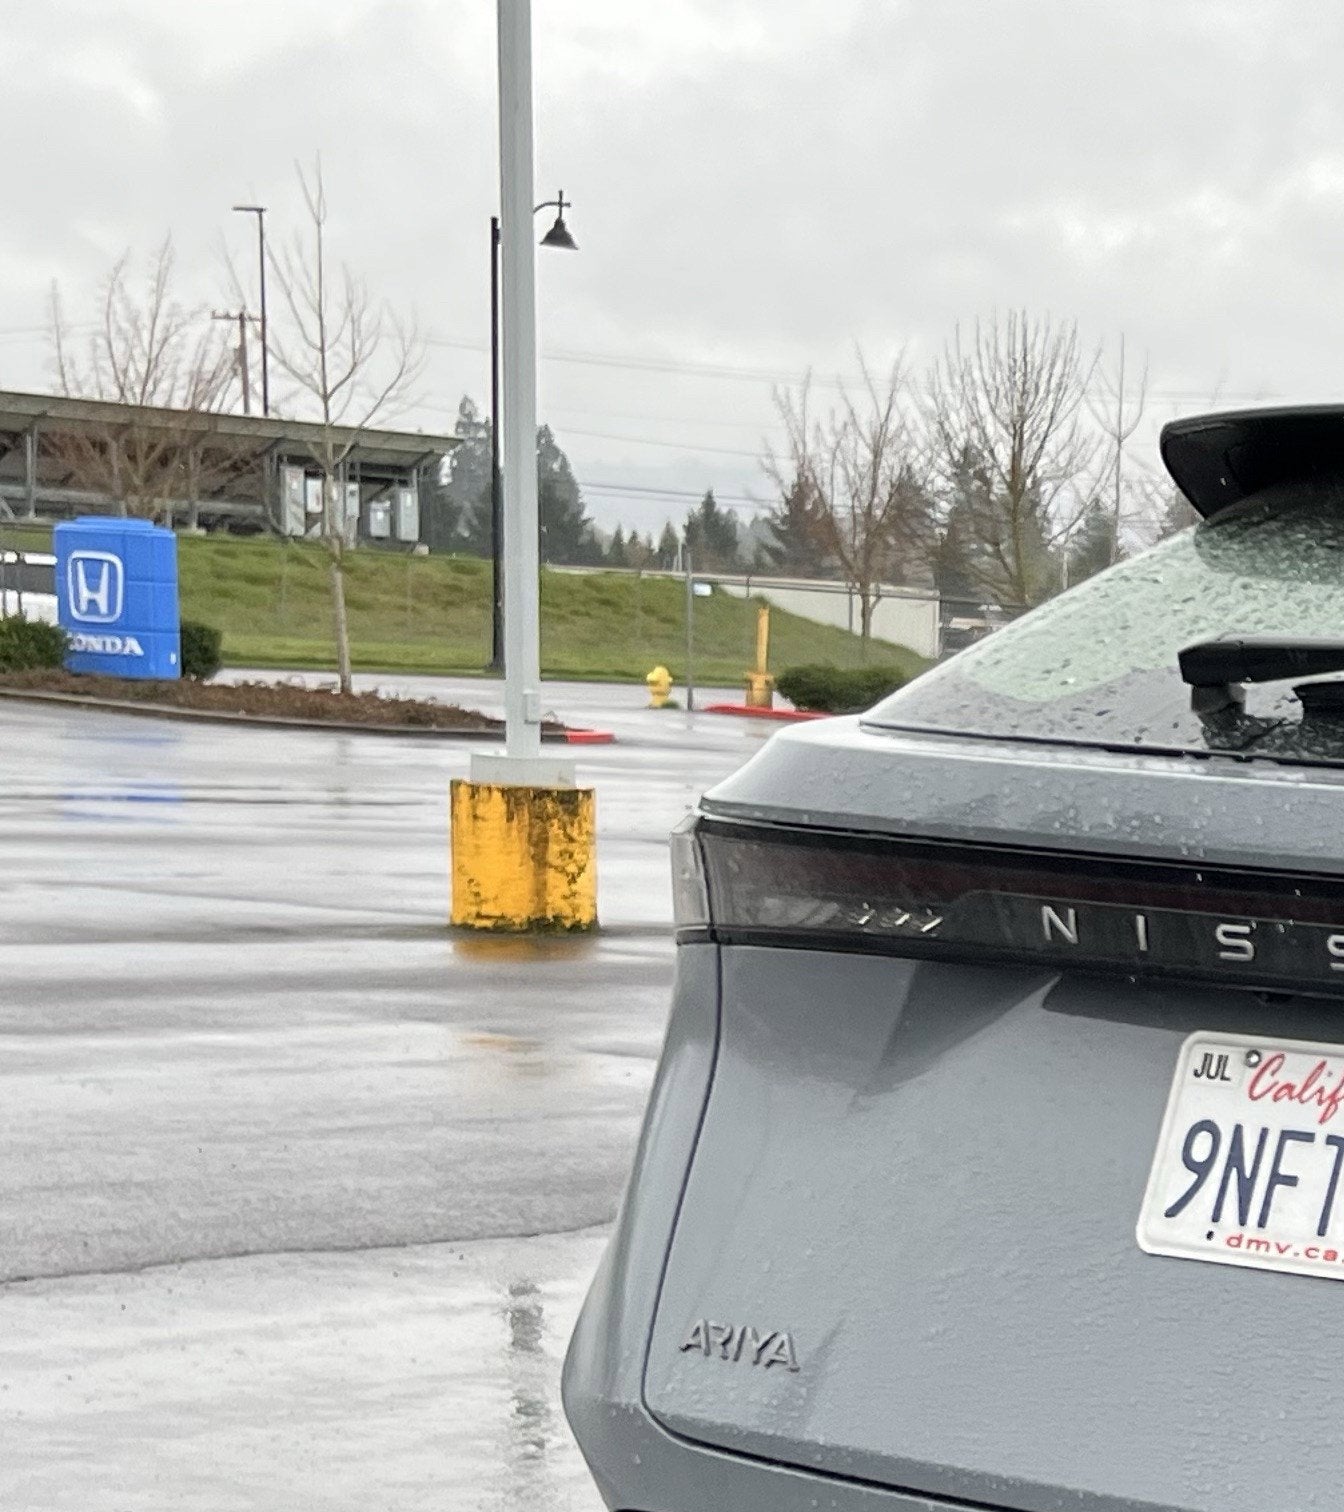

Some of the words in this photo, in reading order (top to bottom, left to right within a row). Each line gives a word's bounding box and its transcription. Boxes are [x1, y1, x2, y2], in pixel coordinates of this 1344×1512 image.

[67, 632, 145, 657] ONDA
[1193, 1052, 1231, 1083] JUL
[679, 1318, 801, 1373] ARIYA
